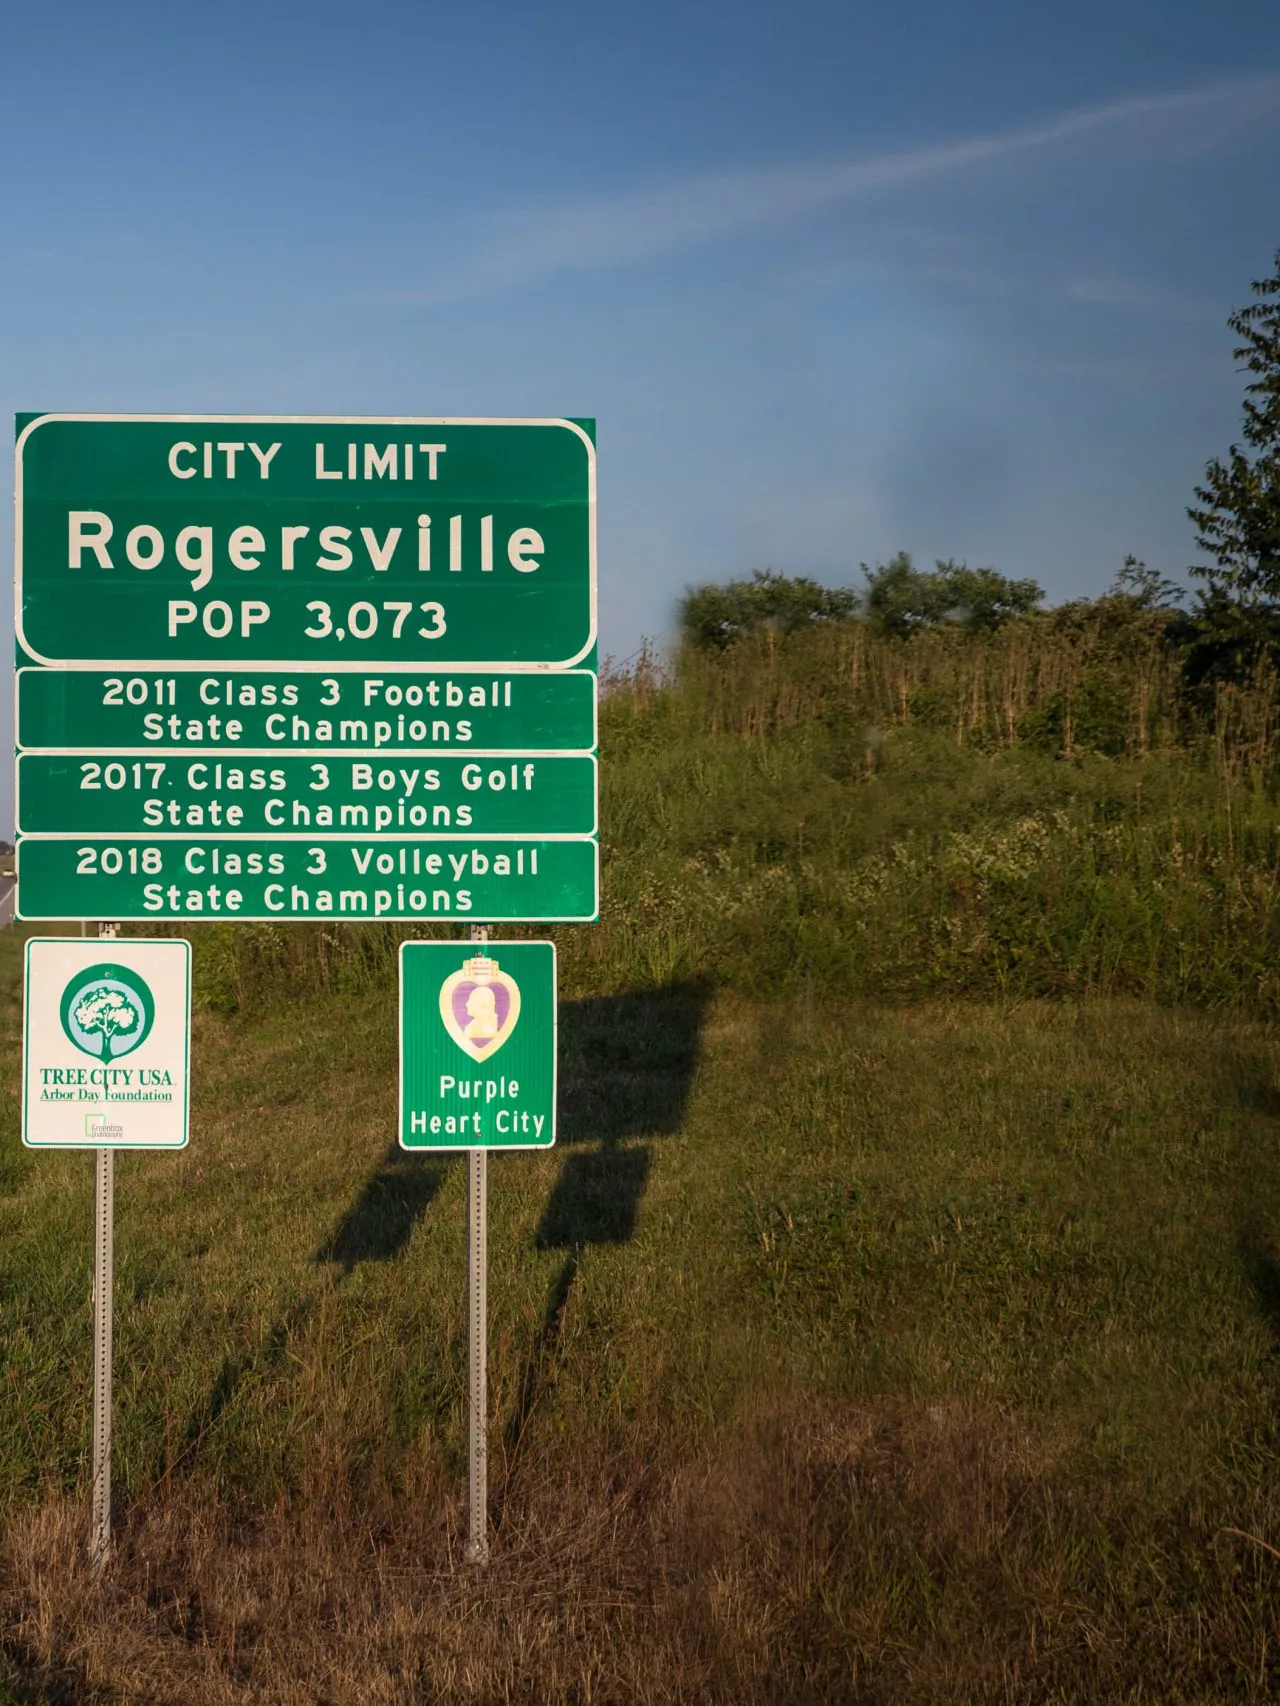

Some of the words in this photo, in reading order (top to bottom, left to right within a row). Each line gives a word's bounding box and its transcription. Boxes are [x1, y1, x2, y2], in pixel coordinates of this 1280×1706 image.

[169, 442, 282, 479] CITY
[315, 443, 447, 480] LIMIT
[68, 510, 545, 592] Rogersville
[168, 600, 271, 638] POP
[305, 601, 447, 641] 3,073
[102, 678, 176, 706] 2011
[200, 678, 299, 706] Class
[320, 678, 341, 706] 3
[364, 680, 512, 707] Football
[143, 713, 243, 741] State
[265, 713, 473, 747] Champions
[80, 763, 166, 790] 2017
[187, 763, 286, 790] Class
[309, 764, 330, 790] 3
[352, 764, 440, 797] Boys
[462, 764, 535, 791] Golf
[143, 798, 243, 826] State
[265, 798, 473, 831] Champions
[76, 847, 162, 875] 2018
[185, 848, 285, 875] Class
[306, 848, 327, 875] 3
[351, 848, 538, 881] Volleyball
[143, 883, 243, 911] State
[265, 883, 473, 917] Champions
[40, 1068, 87, 1085] TREE
[90, 1069, 133, 1086] CITY
[139, 1069, 172, 1086] USA
[440, 1075, 520, 1103] Purple
[40, 1088, 74, 1100] Arbor
[78, 1088, 100, 1104] Day
[104, 1089, 172, 1101] Foundation
[411, 1110, 482, 1134] Heart
[495, 1110, 545, 1137] City
